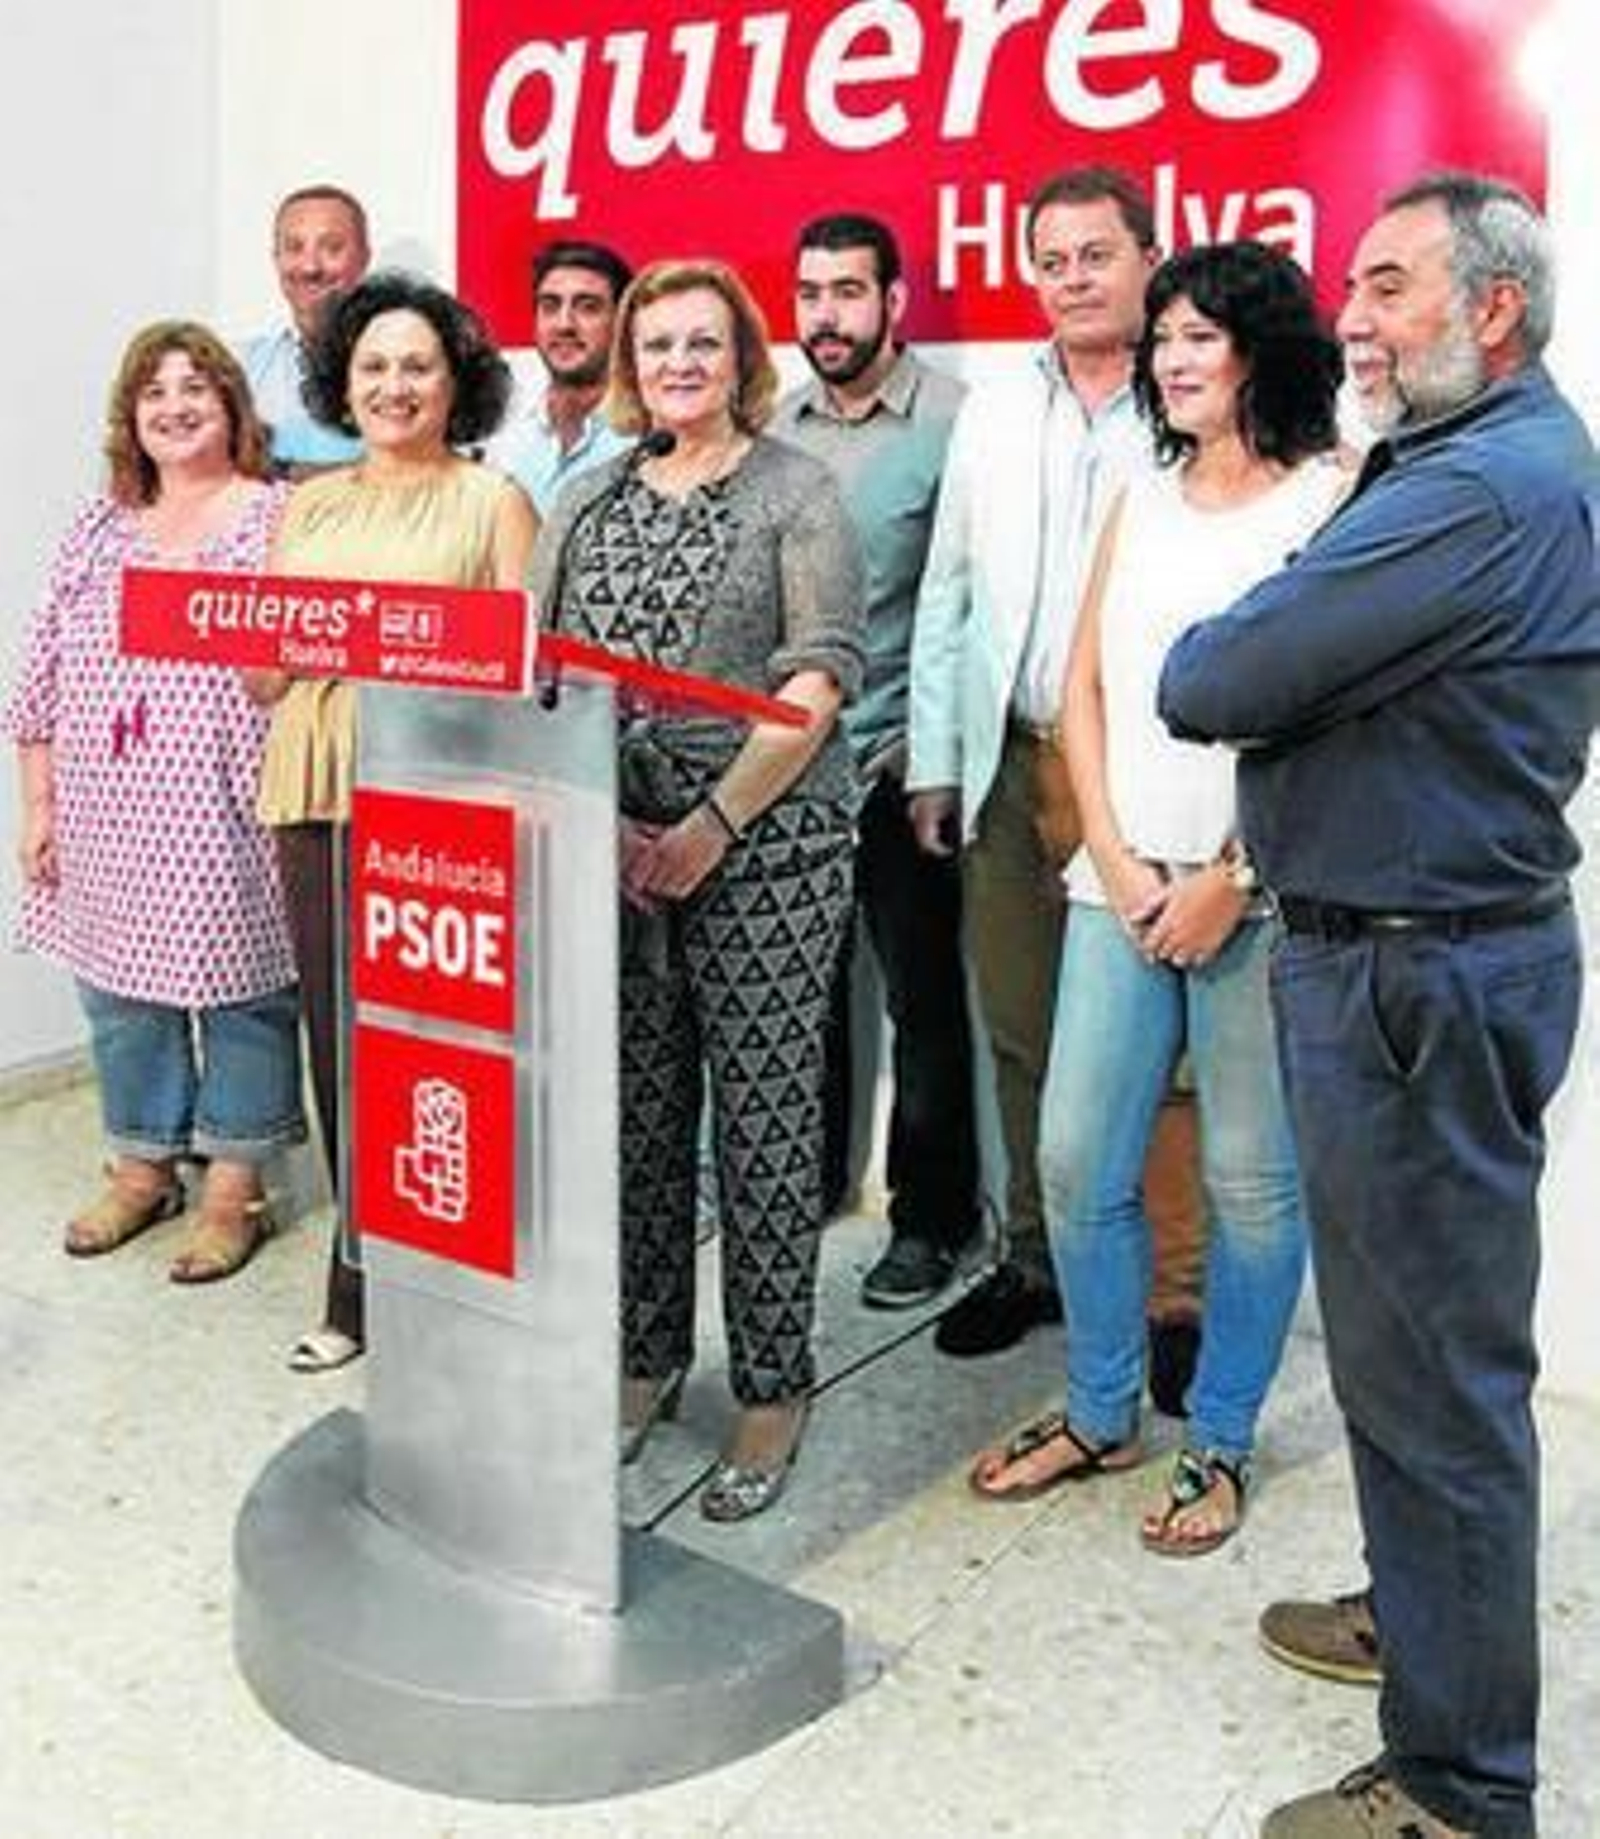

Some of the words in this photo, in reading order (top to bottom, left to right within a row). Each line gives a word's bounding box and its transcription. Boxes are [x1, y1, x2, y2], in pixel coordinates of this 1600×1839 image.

[480, 0, 1323, 220] quieres
[937, 163, 1315, 290] Hlva
[364, 893, 505, 987] PSOE
